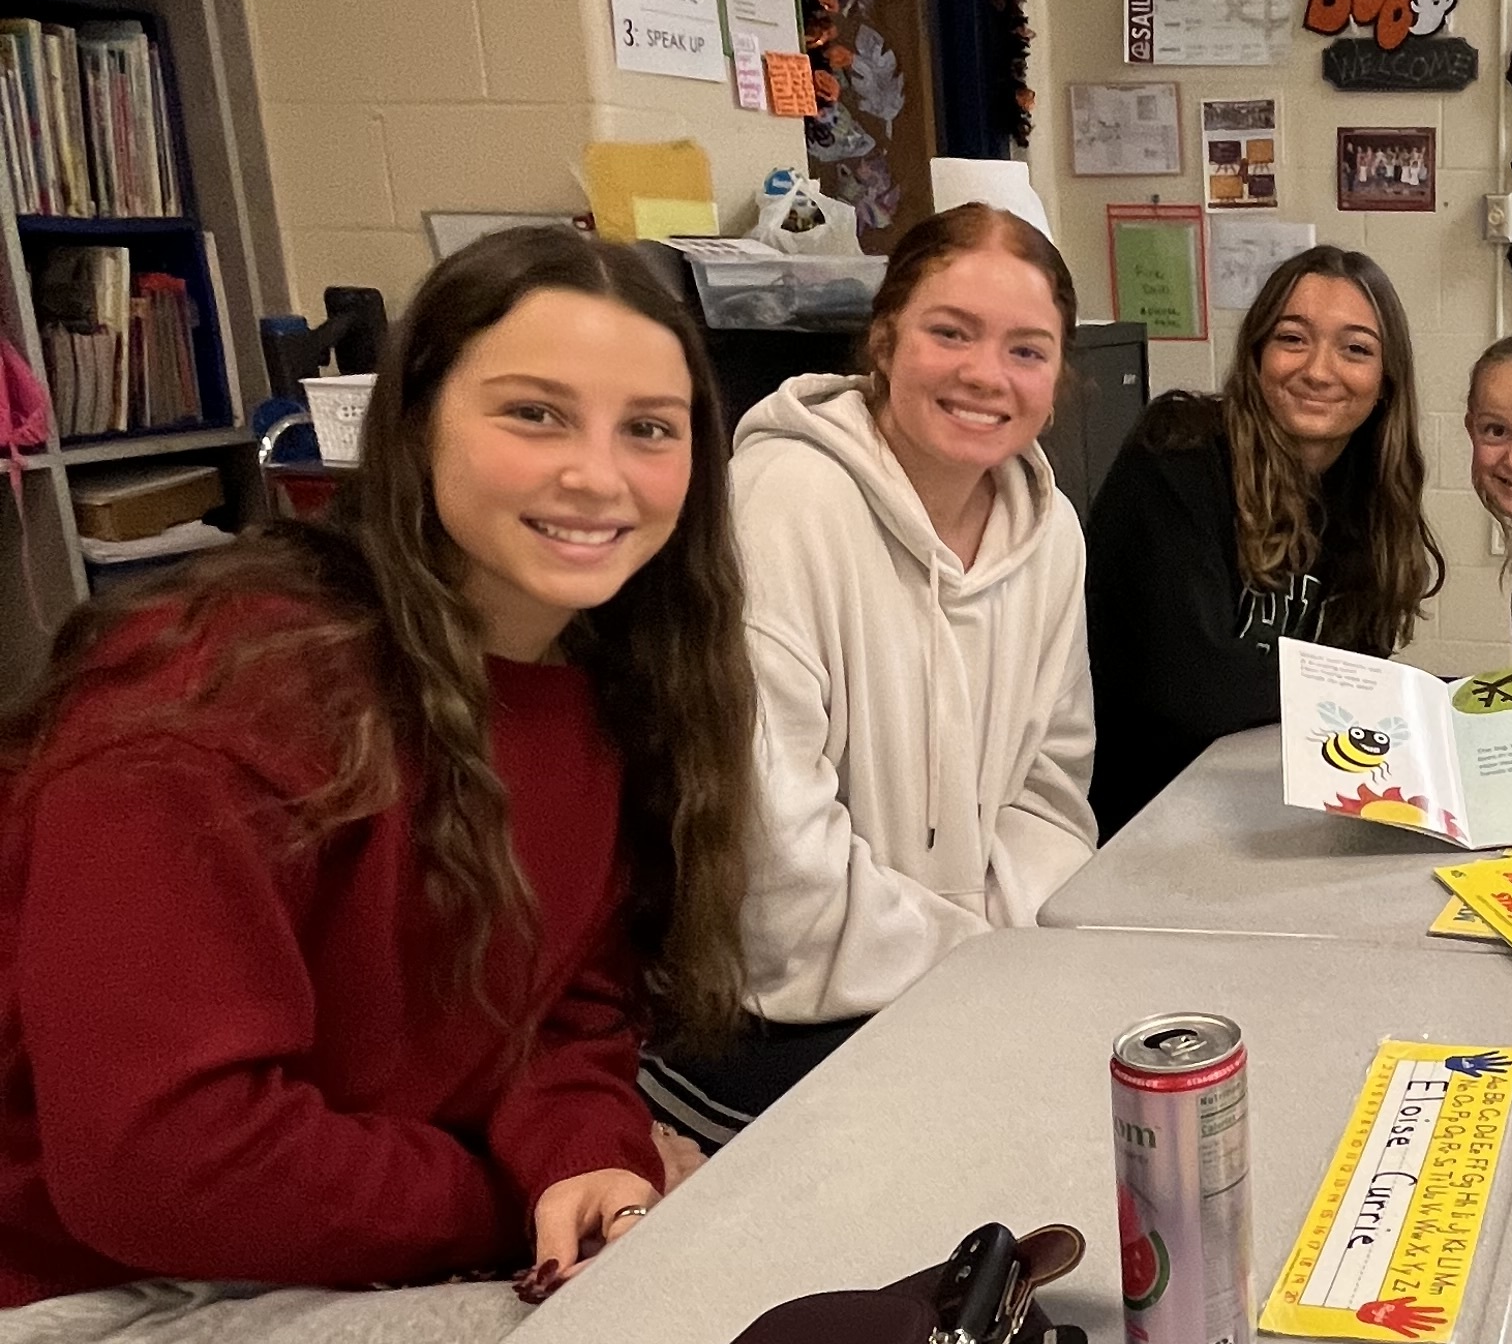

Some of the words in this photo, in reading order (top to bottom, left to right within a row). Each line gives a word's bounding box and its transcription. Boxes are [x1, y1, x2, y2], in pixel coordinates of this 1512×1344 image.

[624, 19, 639, 47] 3:
[647, 29, 686, 51] SPEAK
[690, 38, 704, 53] UP
[1330, 52, 1472, 81] WELCOME
[1386, 1081, 1449, 1148] Eloise
[1347, 1172, 1418, 1249] Currie
